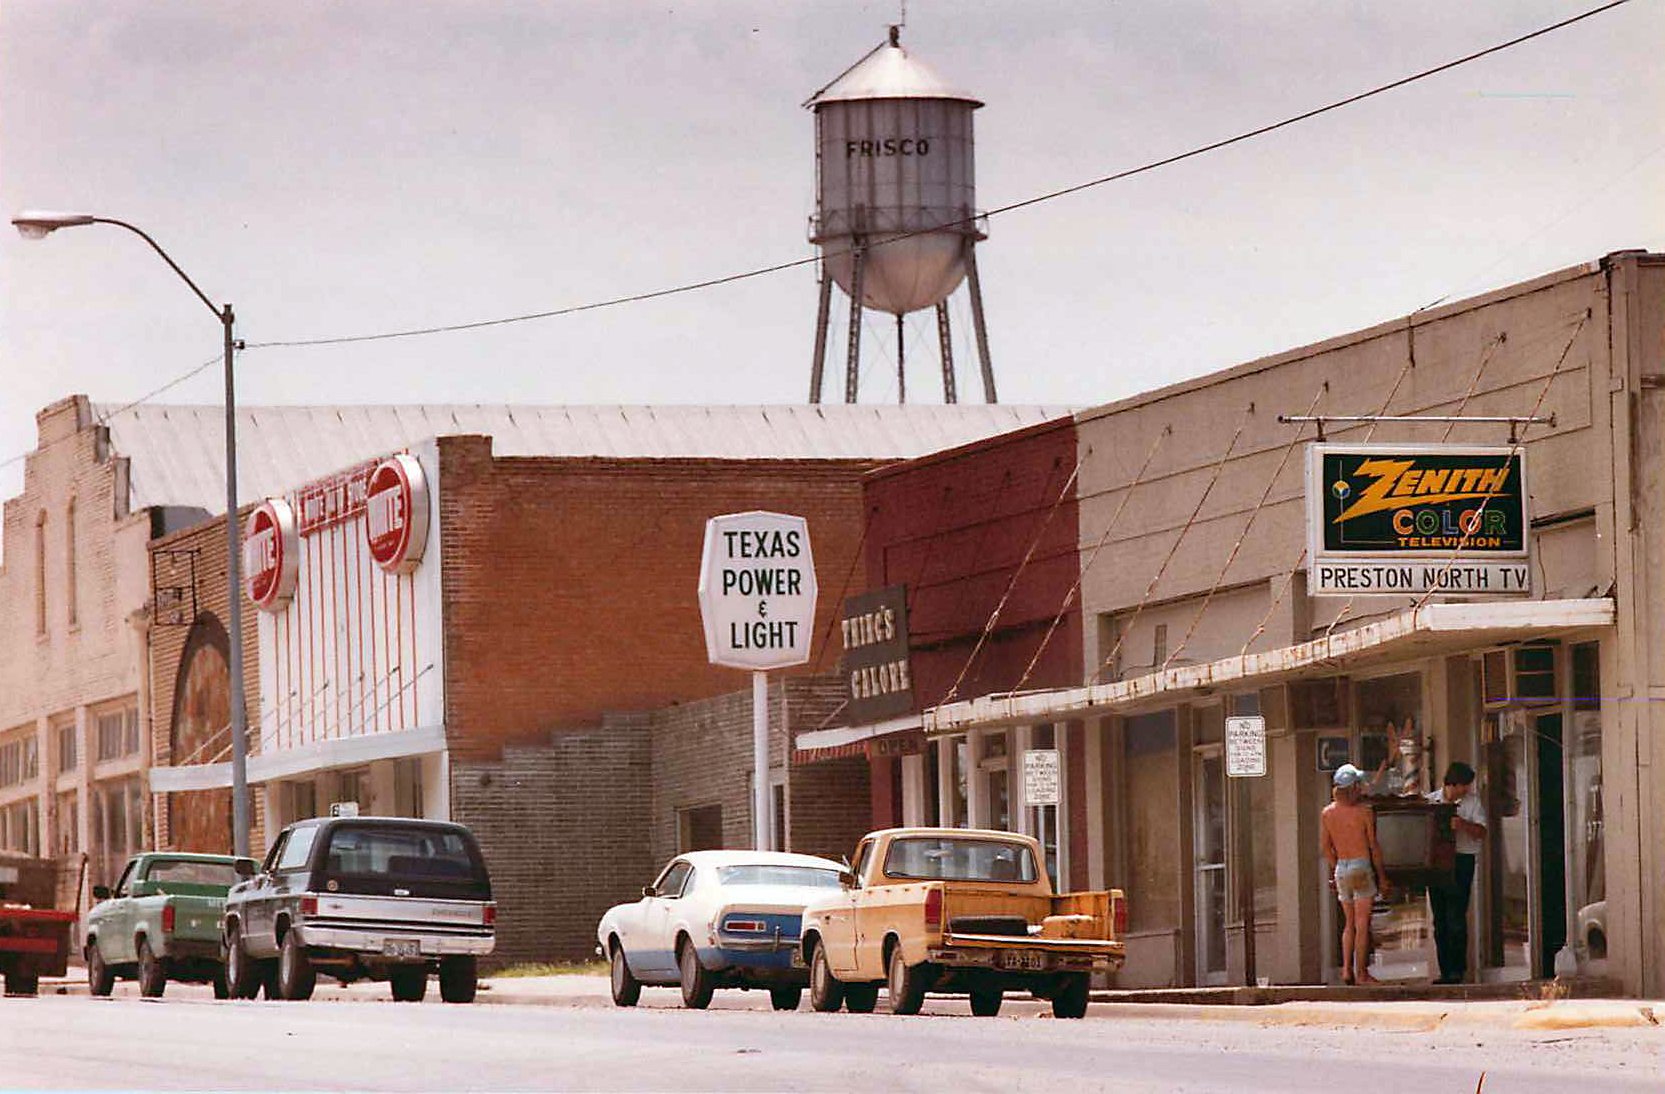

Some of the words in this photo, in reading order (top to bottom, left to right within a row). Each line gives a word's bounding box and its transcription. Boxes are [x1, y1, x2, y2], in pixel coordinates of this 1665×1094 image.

[845, 139, 929, 159] FRISCO
[1332, 457, 1513, 524] ZENITH
[1392, 509, 1506, 536] COLOR
[723, 530, 801, 558] TEXAS
[1398, 537, 1501, 548] TELEVISION
[722, 568, 801, 596] POWER
[1320, 567, 1413, 589] PRESTON
[1422, 567, 1489, 589] NORTH
[1499, 567, 1526, 589] TV
[731, 621, 798, 649] LIGHT
[850, 659, 910, 700] GALORE
